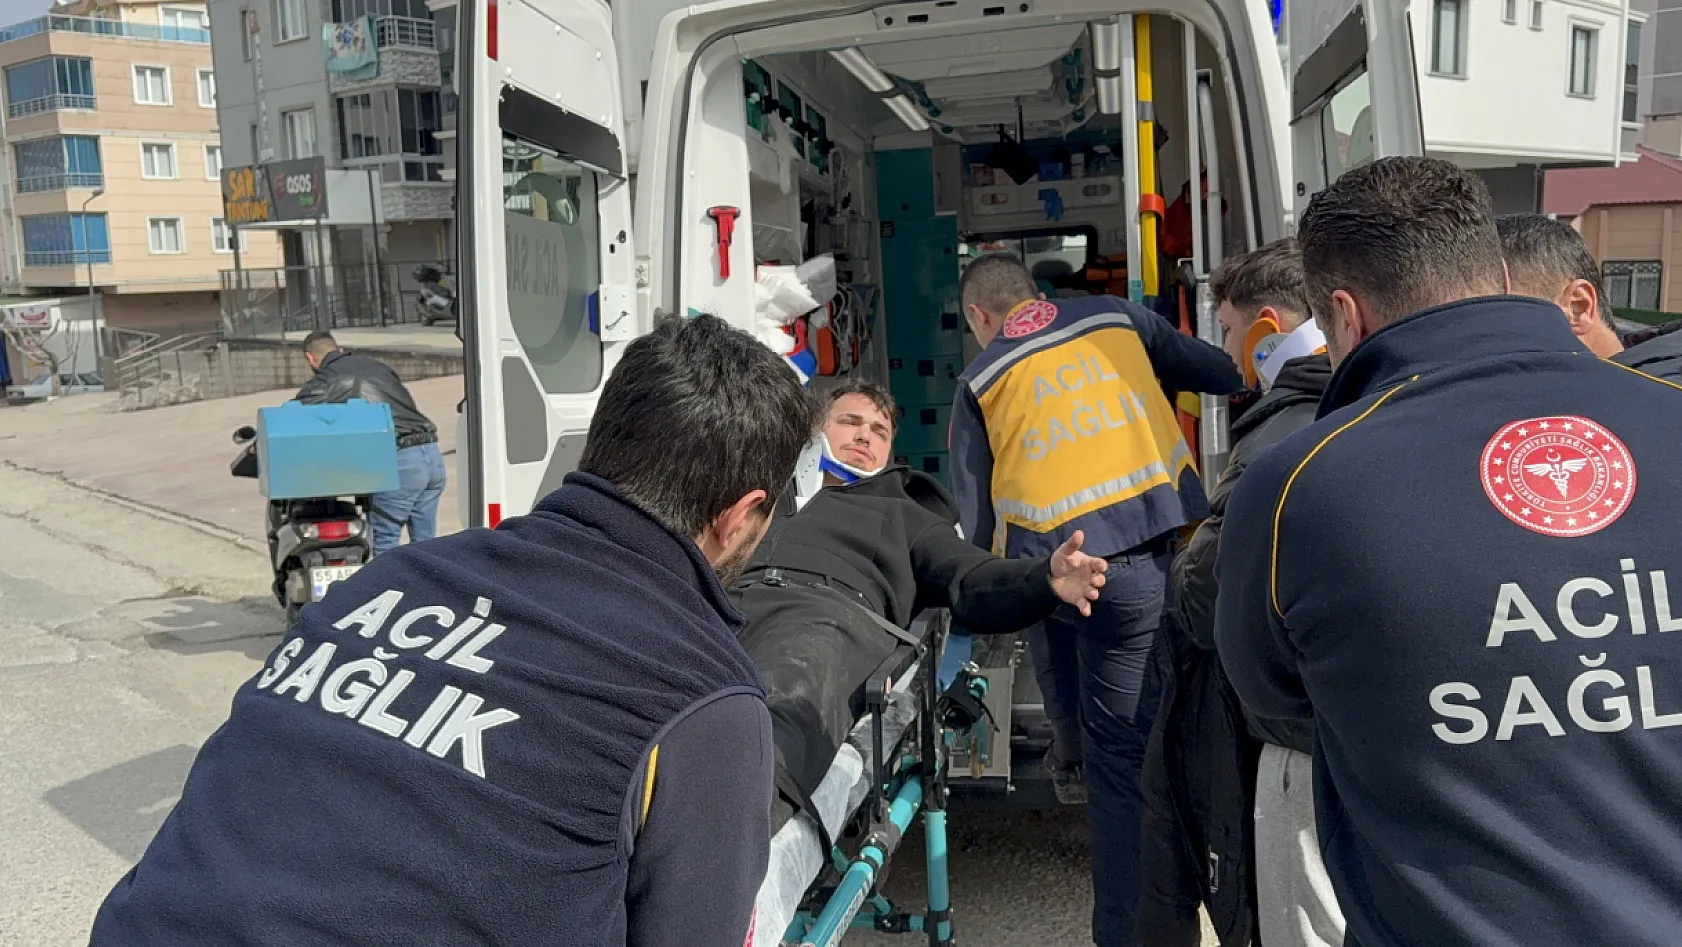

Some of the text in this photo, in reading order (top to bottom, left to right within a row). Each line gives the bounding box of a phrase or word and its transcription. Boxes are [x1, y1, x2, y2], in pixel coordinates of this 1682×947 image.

[1034, 353, 1118, 407] ACİL
[332, 589, 506, 673] ACİL
[1485, 558, 1682, 647] ACİL
[257, 637, 520, 778] SAĞLIK
[1429, 653, 1682, 744] SAĞL
